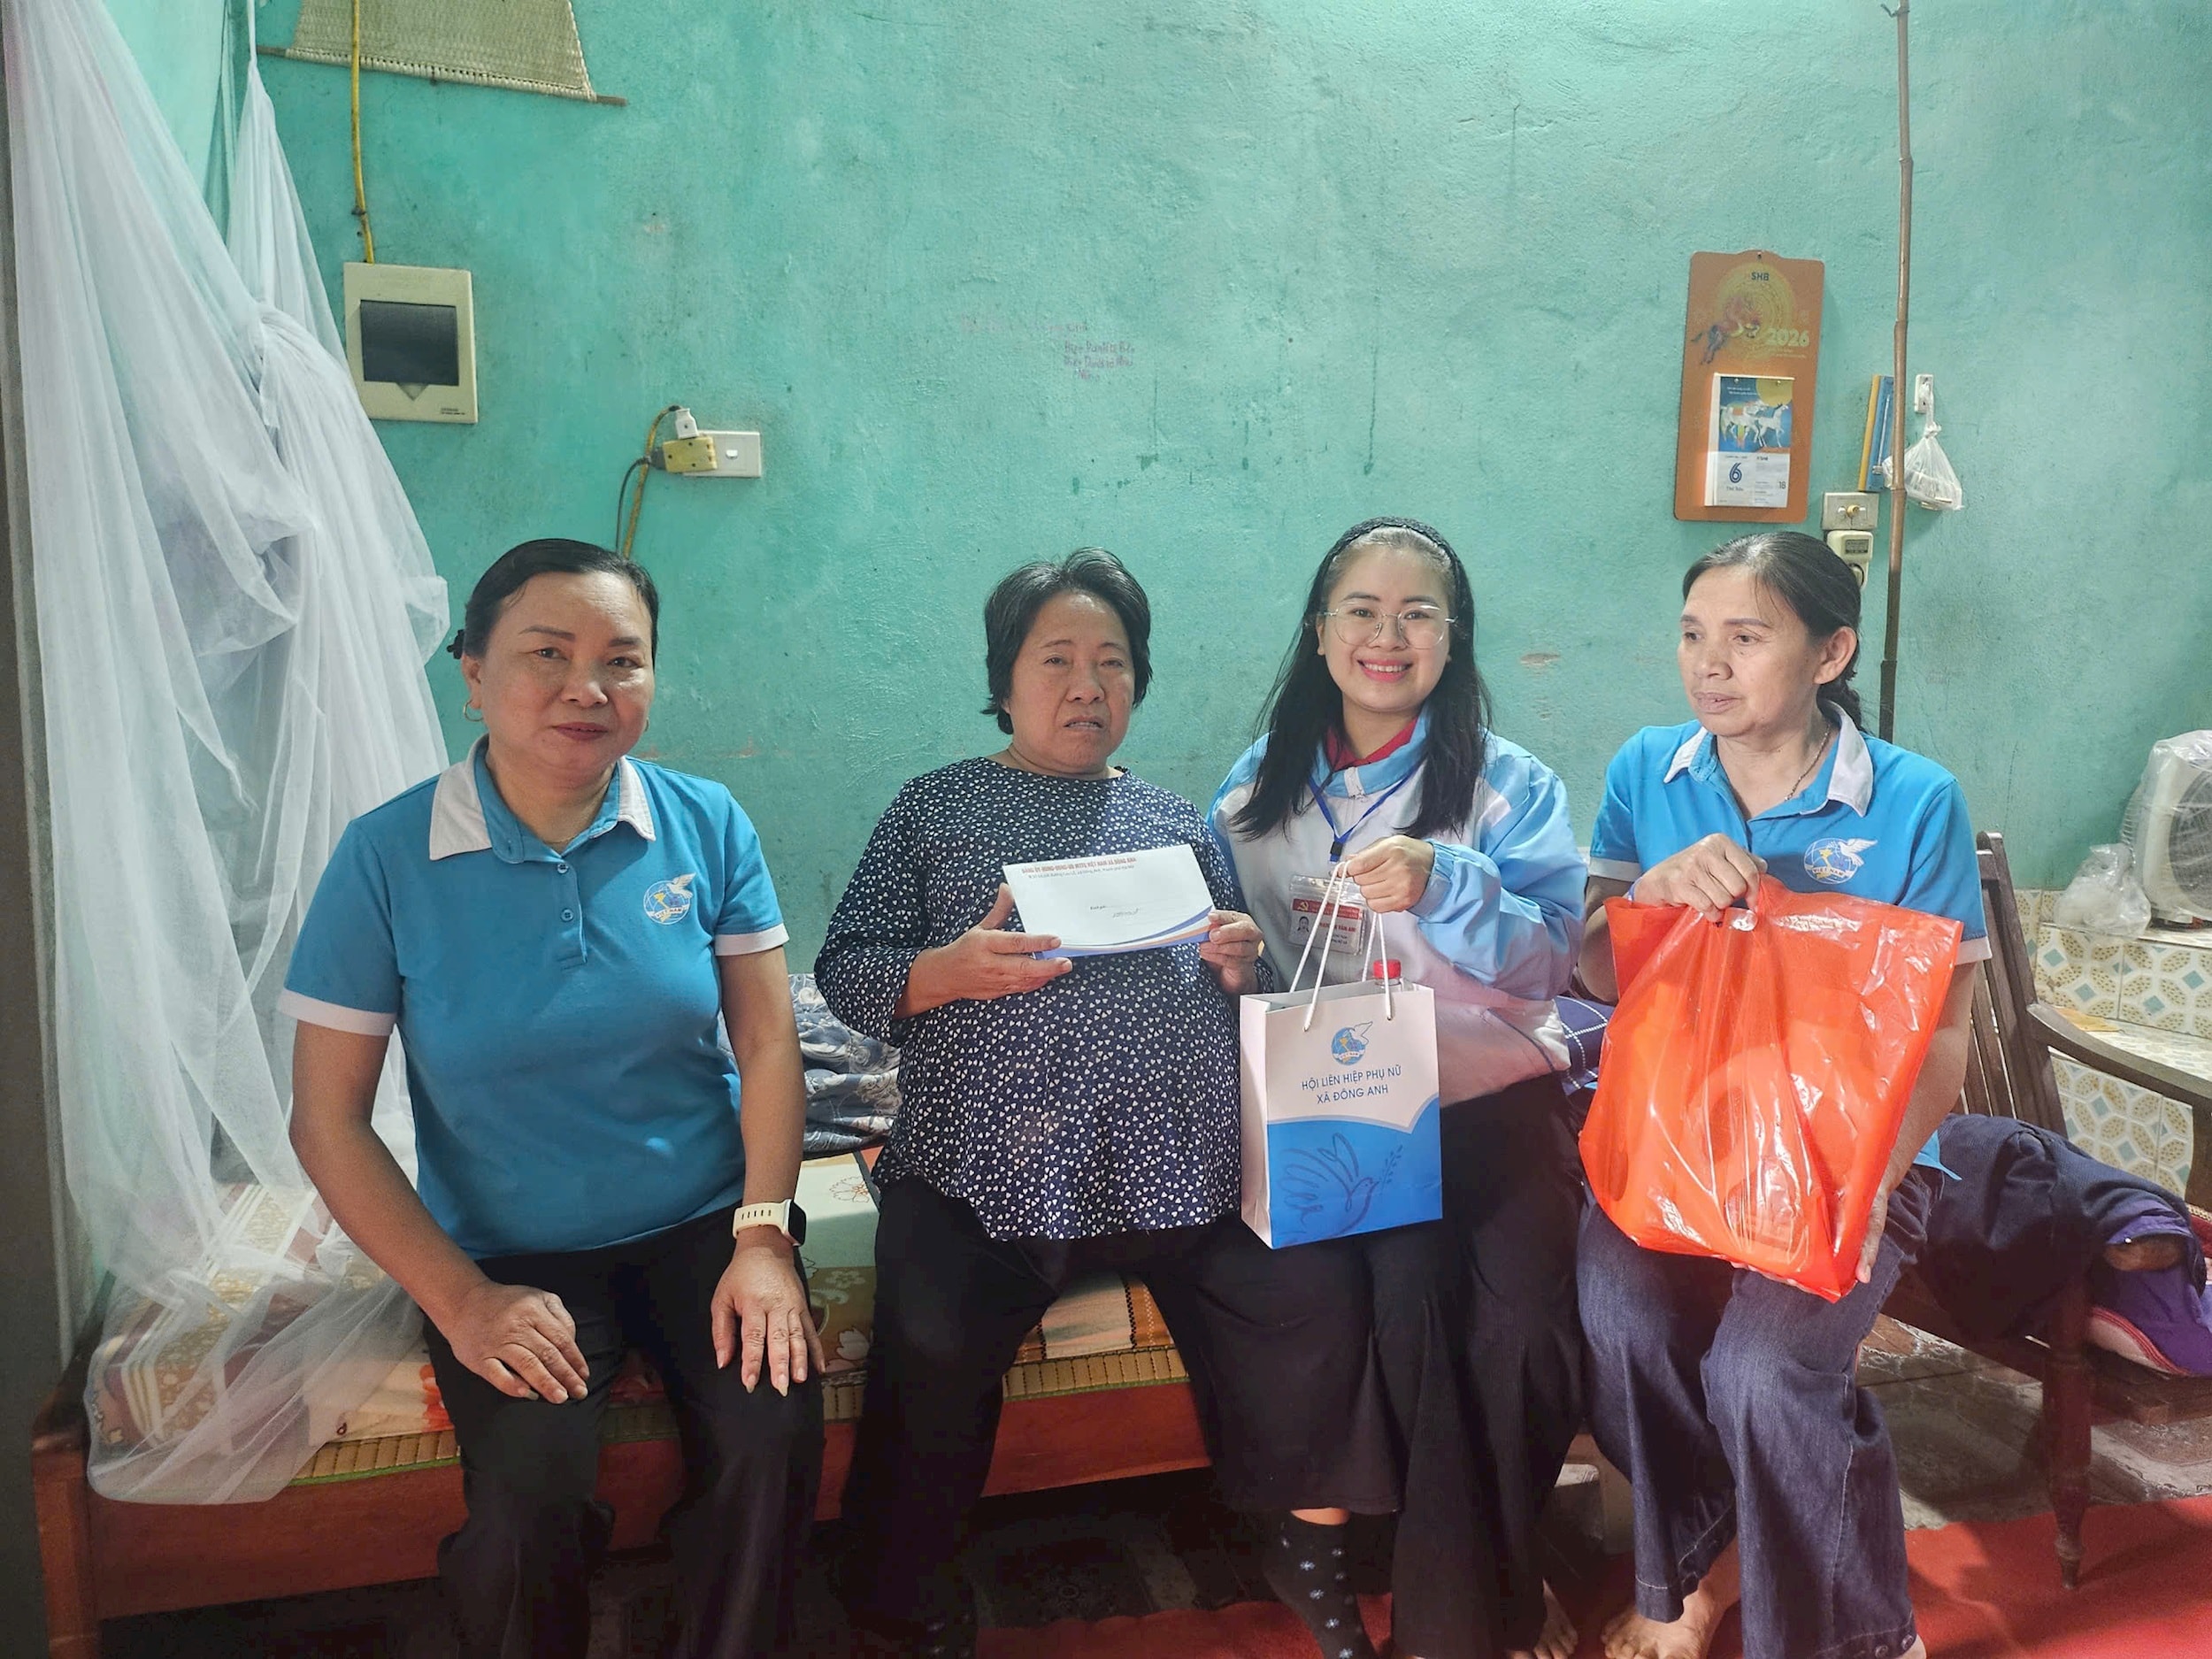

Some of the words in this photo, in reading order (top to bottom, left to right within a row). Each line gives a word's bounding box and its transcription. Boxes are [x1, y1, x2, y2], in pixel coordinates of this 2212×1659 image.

[1751, 272, 1770, 281] SHB
[1765, 327, 1810, 347] 2026
[1729, 462, 1742, 484] 6
[1778, 480, 1786, 489] 18
[1302, 1077, 1319, 1091] HỘI
[1321, 1074, 1340, 1087] LIÊN
[1343, 1070, 1363, 1084] HIỆP
[1366, 1068, 1385, 1080] PHỤ
[1387, 1064, 1402, 1077] NỮ
[1317, 1091, 1331, 1104] XÃ
[1333, 1087, 1363, 1102] ĐÔNG
[1367, 1084, 1388, 1096] ANH
